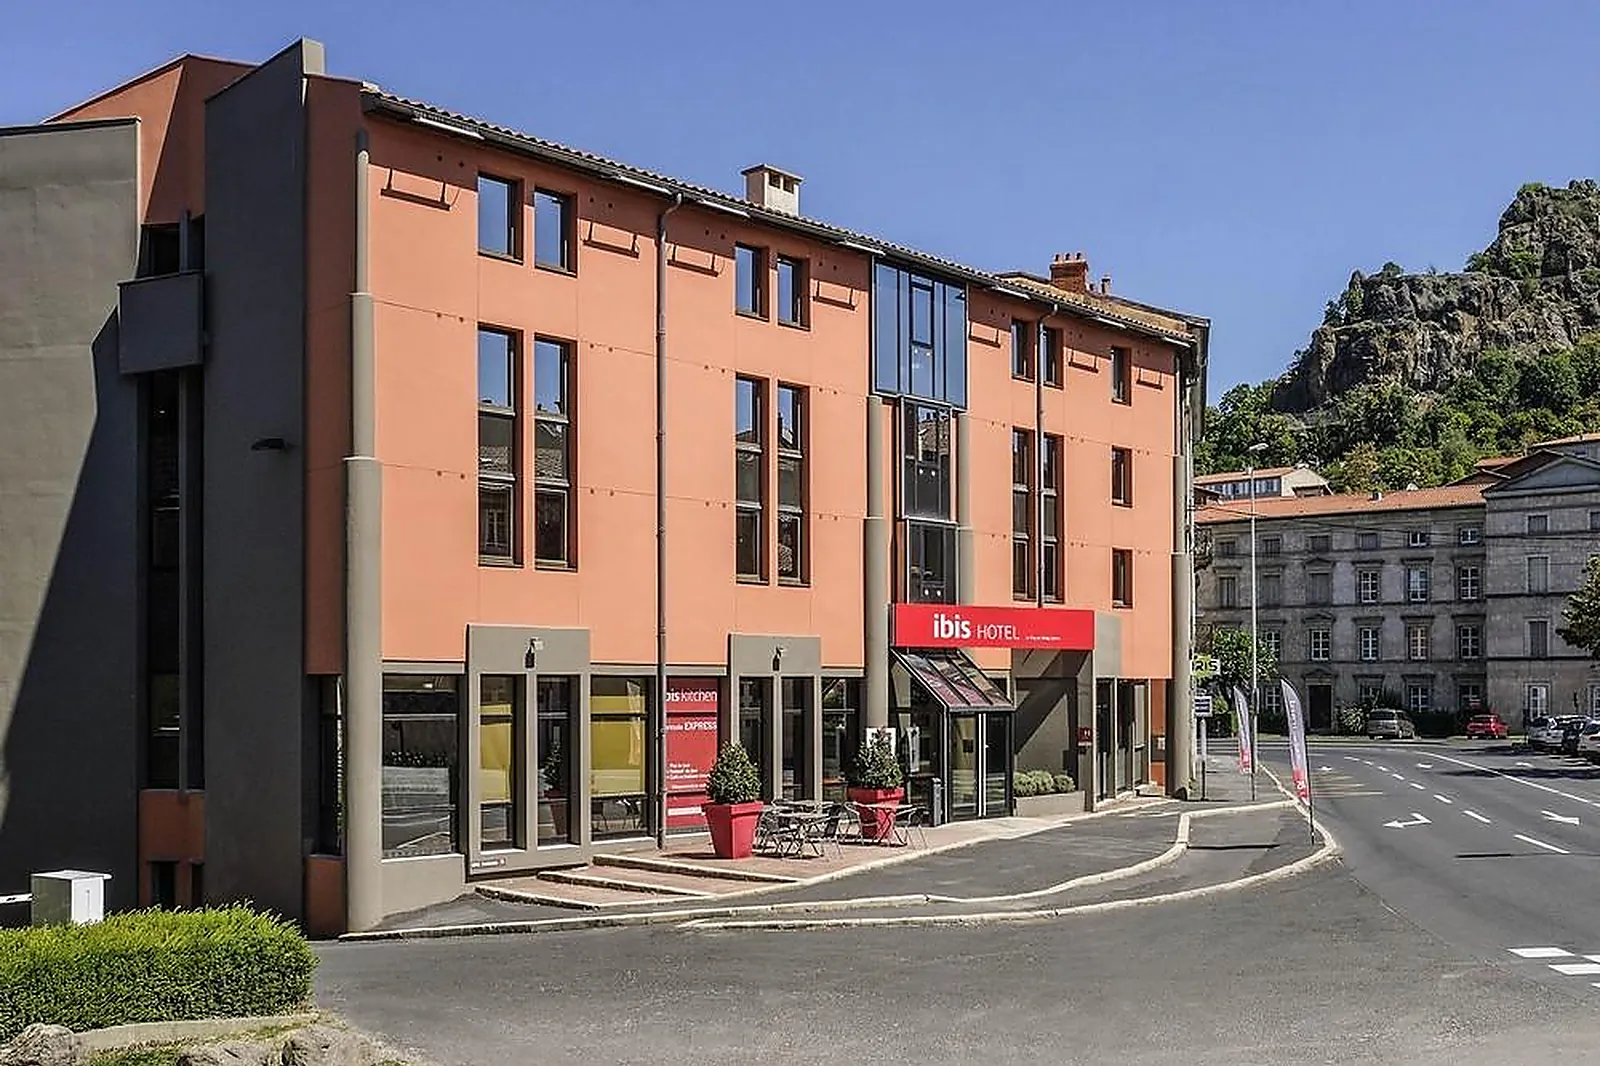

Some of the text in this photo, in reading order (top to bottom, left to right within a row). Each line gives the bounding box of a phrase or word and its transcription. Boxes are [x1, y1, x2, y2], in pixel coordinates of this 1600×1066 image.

[933, 613, 1020, 640] ibis HOTEL
[680, 688, 718, 702] kitchen
